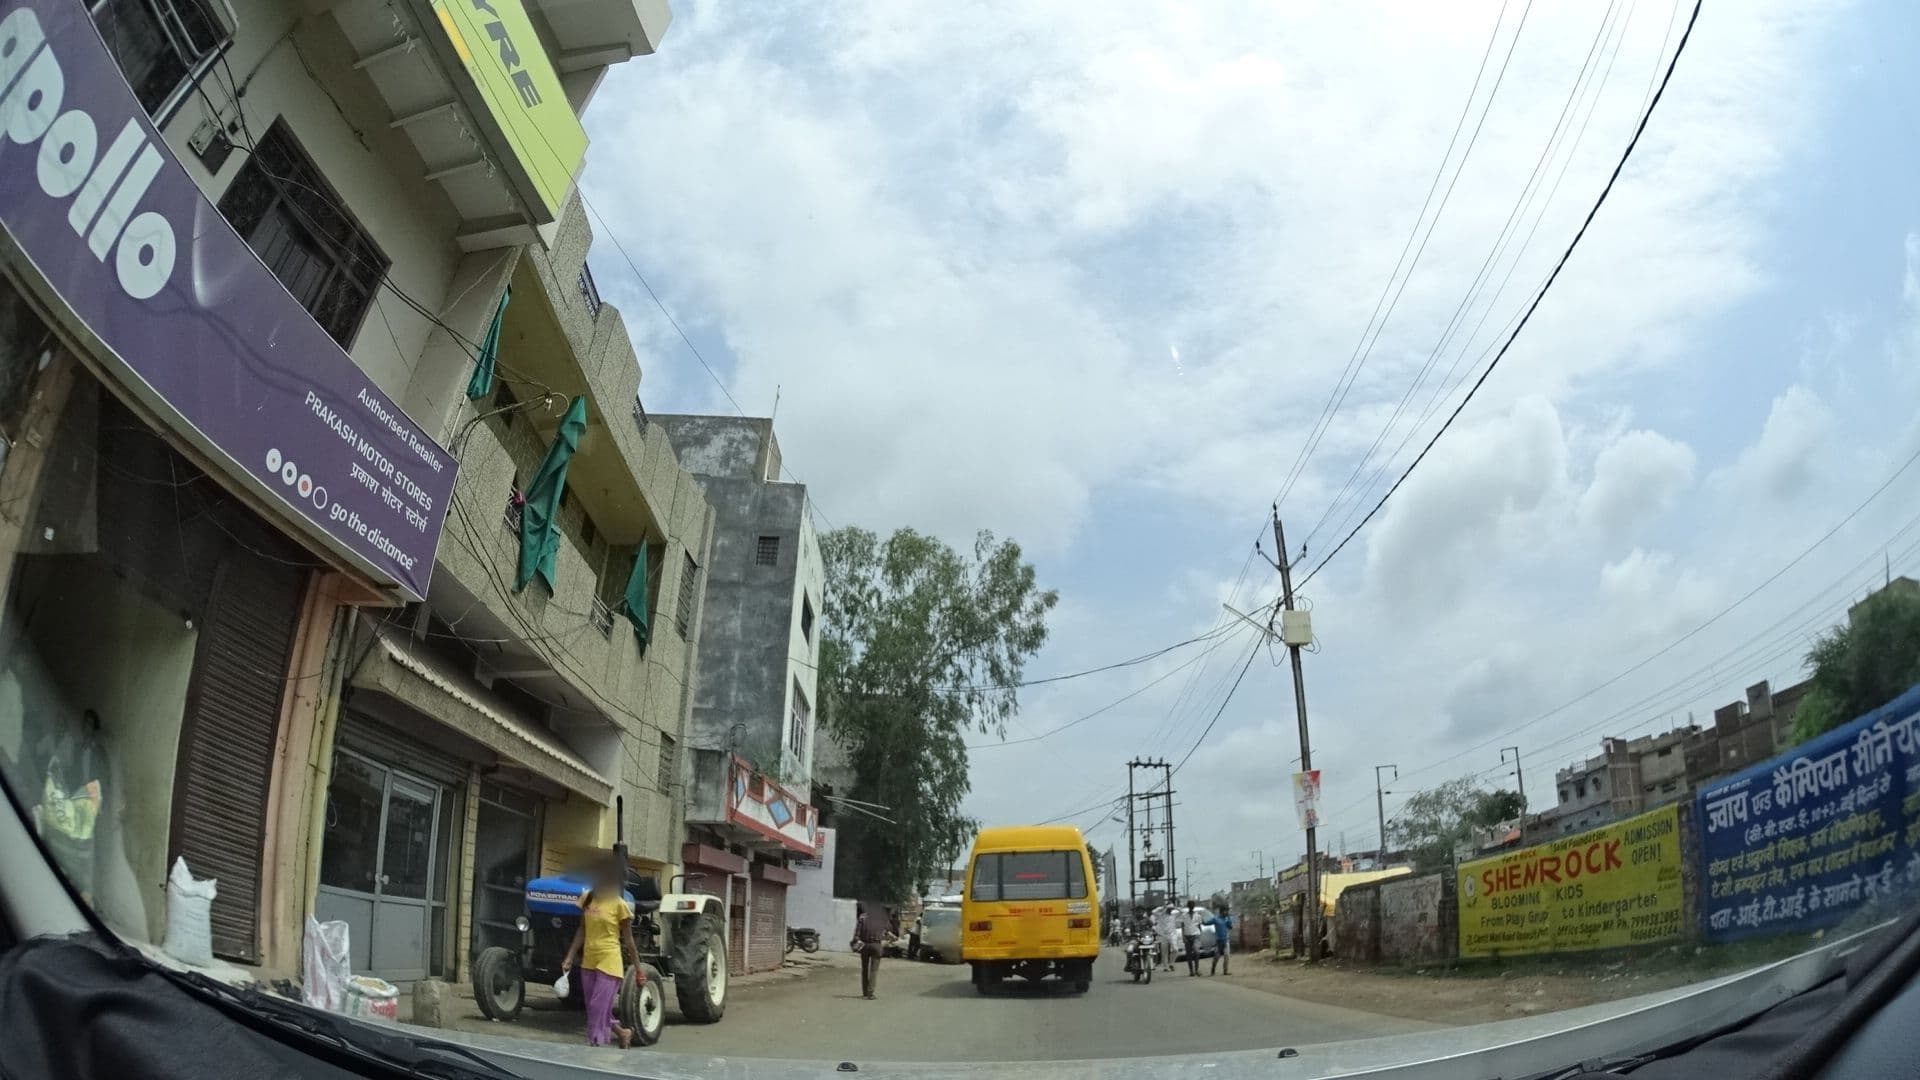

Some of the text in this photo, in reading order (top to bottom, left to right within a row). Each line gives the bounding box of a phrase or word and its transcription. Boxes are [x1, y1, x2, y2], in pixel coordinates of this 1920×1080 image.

[304, 390, 433, 511] PRAKASH MOTOR STORES
[357, 387, 443, 473] Authorised Retailer
[350, 462, 428, 533] प्रकाश मोटर स्टोर्स
[329, 502, 415, 571] go the distance
[1624, 818, 1673, 846] ADMISSION
[1631, 843, 1662, 865] OPEN!
[1482, 838, 1622, 897] SHENROCK
[1555, 884, 1584, 901] KIDS
[1578, 893, 1657, 918] Kindergarten
